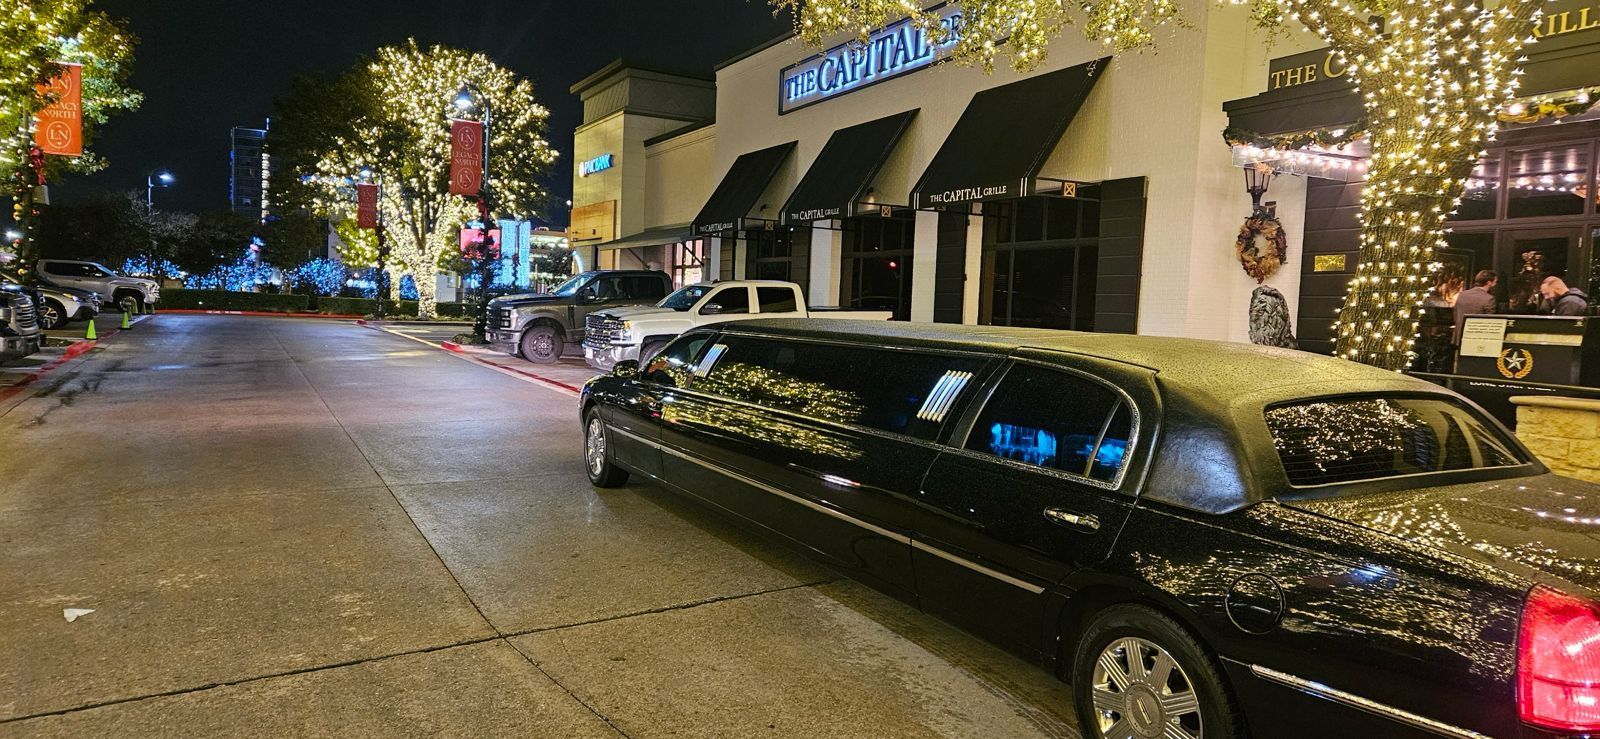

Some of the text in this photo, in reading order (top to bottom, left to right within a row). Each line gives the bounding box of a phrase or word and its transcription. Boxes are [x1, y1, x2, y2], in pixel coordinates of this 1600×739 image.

[785, 69, 816, 99] THE
[817, 27, 933, 92] CAPITAL
[1271, 63, 1317, 89] THE
[42, 109, 77, 119] NORTH
[930, 185, 1007, 203] THE CAPITAL GRILLE
[800, 208, 825, 220] CAPITAL
